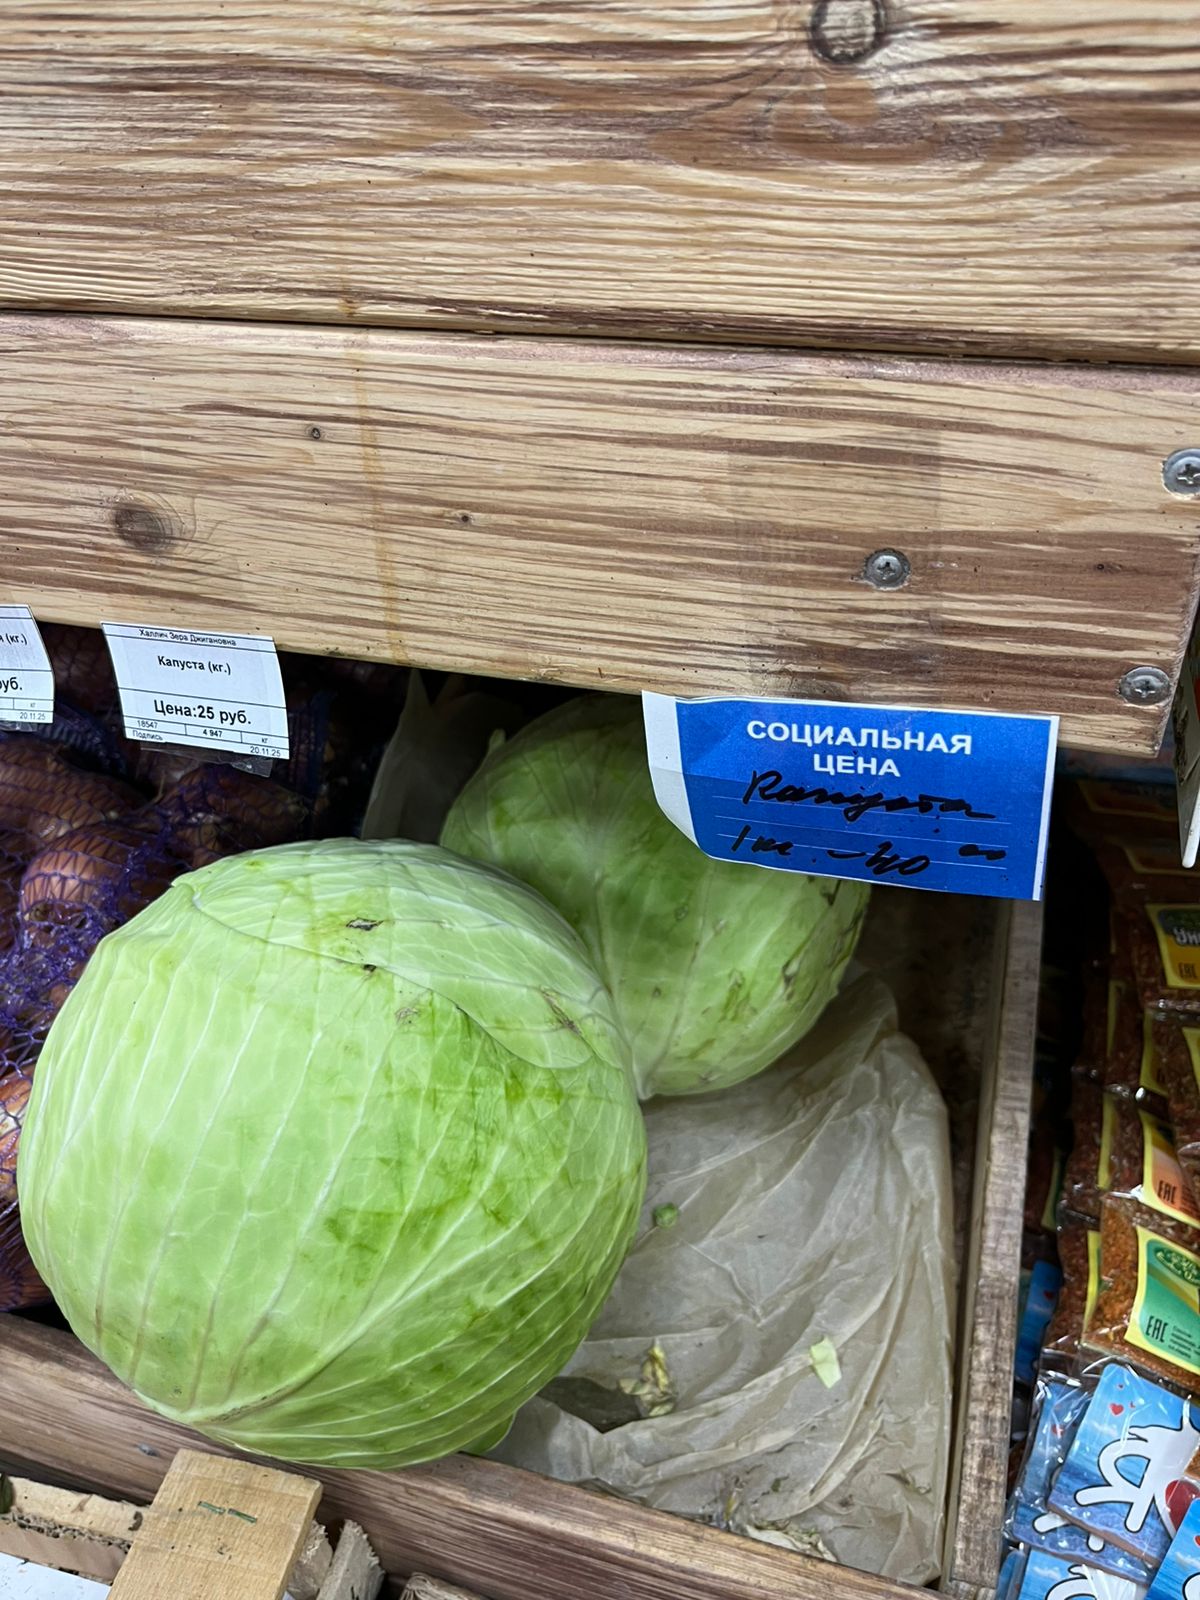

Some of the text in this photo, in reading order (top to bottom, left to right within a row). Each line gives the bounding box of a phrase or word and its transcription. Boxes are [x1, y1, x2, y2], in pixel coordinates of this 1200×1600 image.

[5, 632, 28, 646] (кг.)
[157, 655, 231, 676] Капуста (кг.)
[19, 711, 46, 721] 20.11.25
[154, 699, 252, 725] Цена:25 руб.
[137, 720, 158, 730] 18547
[132, 730, 163, 741] Подпись
[747, 720, 973, 755] СОЦИАЛЬНАЯ
[250, 745, 281, 758] 20.11.25
[813, 753, 901, 778] ЦЕНА
[1145, 1315, 1169, 1343] EAC
